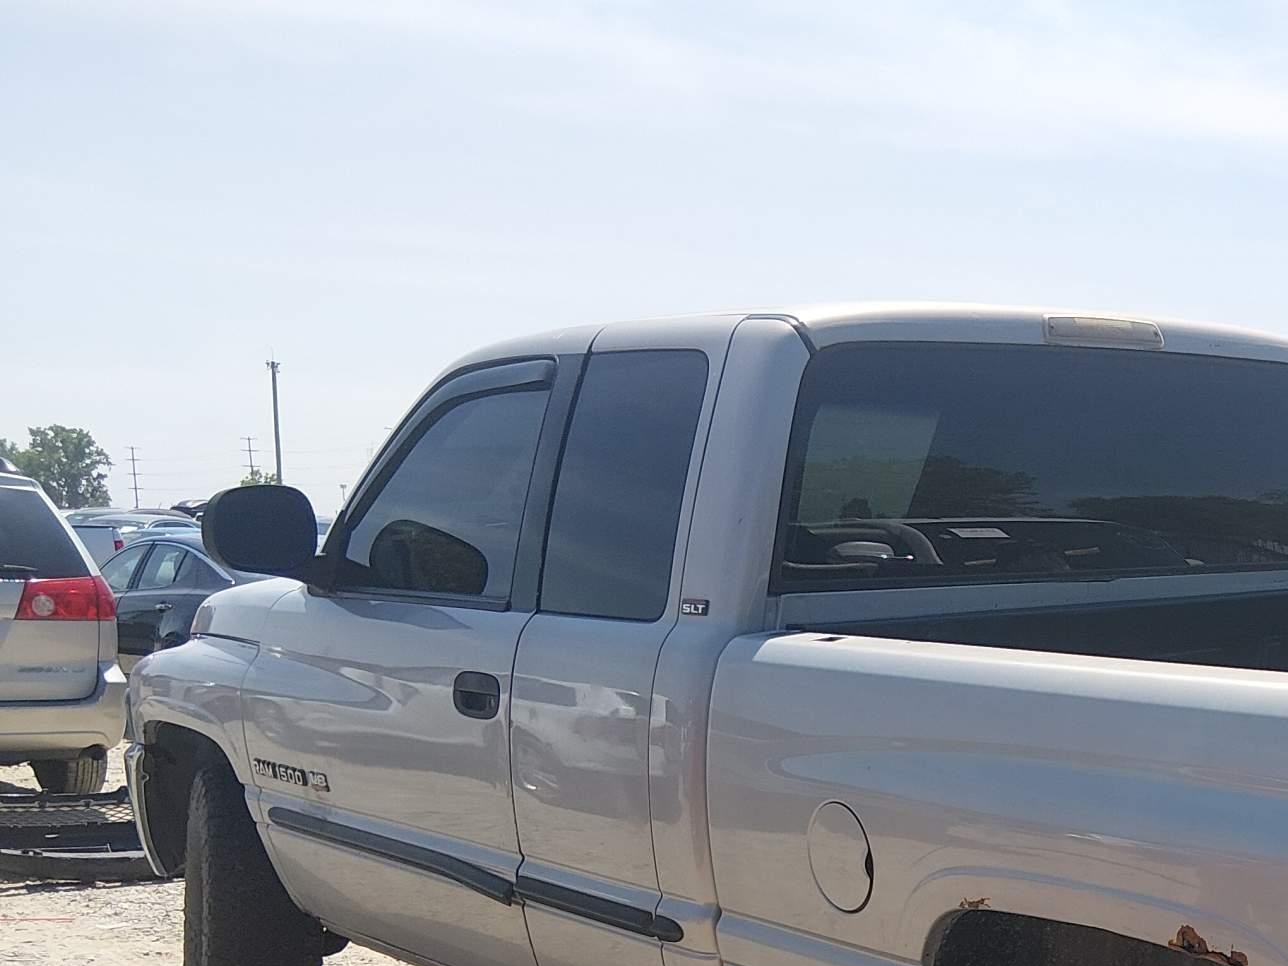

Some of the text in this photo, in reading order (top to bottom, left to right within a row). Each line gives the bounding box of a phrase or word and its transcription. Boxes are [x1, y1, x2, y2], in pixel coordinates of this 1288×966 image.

[682, 603, 706, 614] SLT
[252, 758, 275, 778] RAM
[275, 764, 305, 786] 1500
